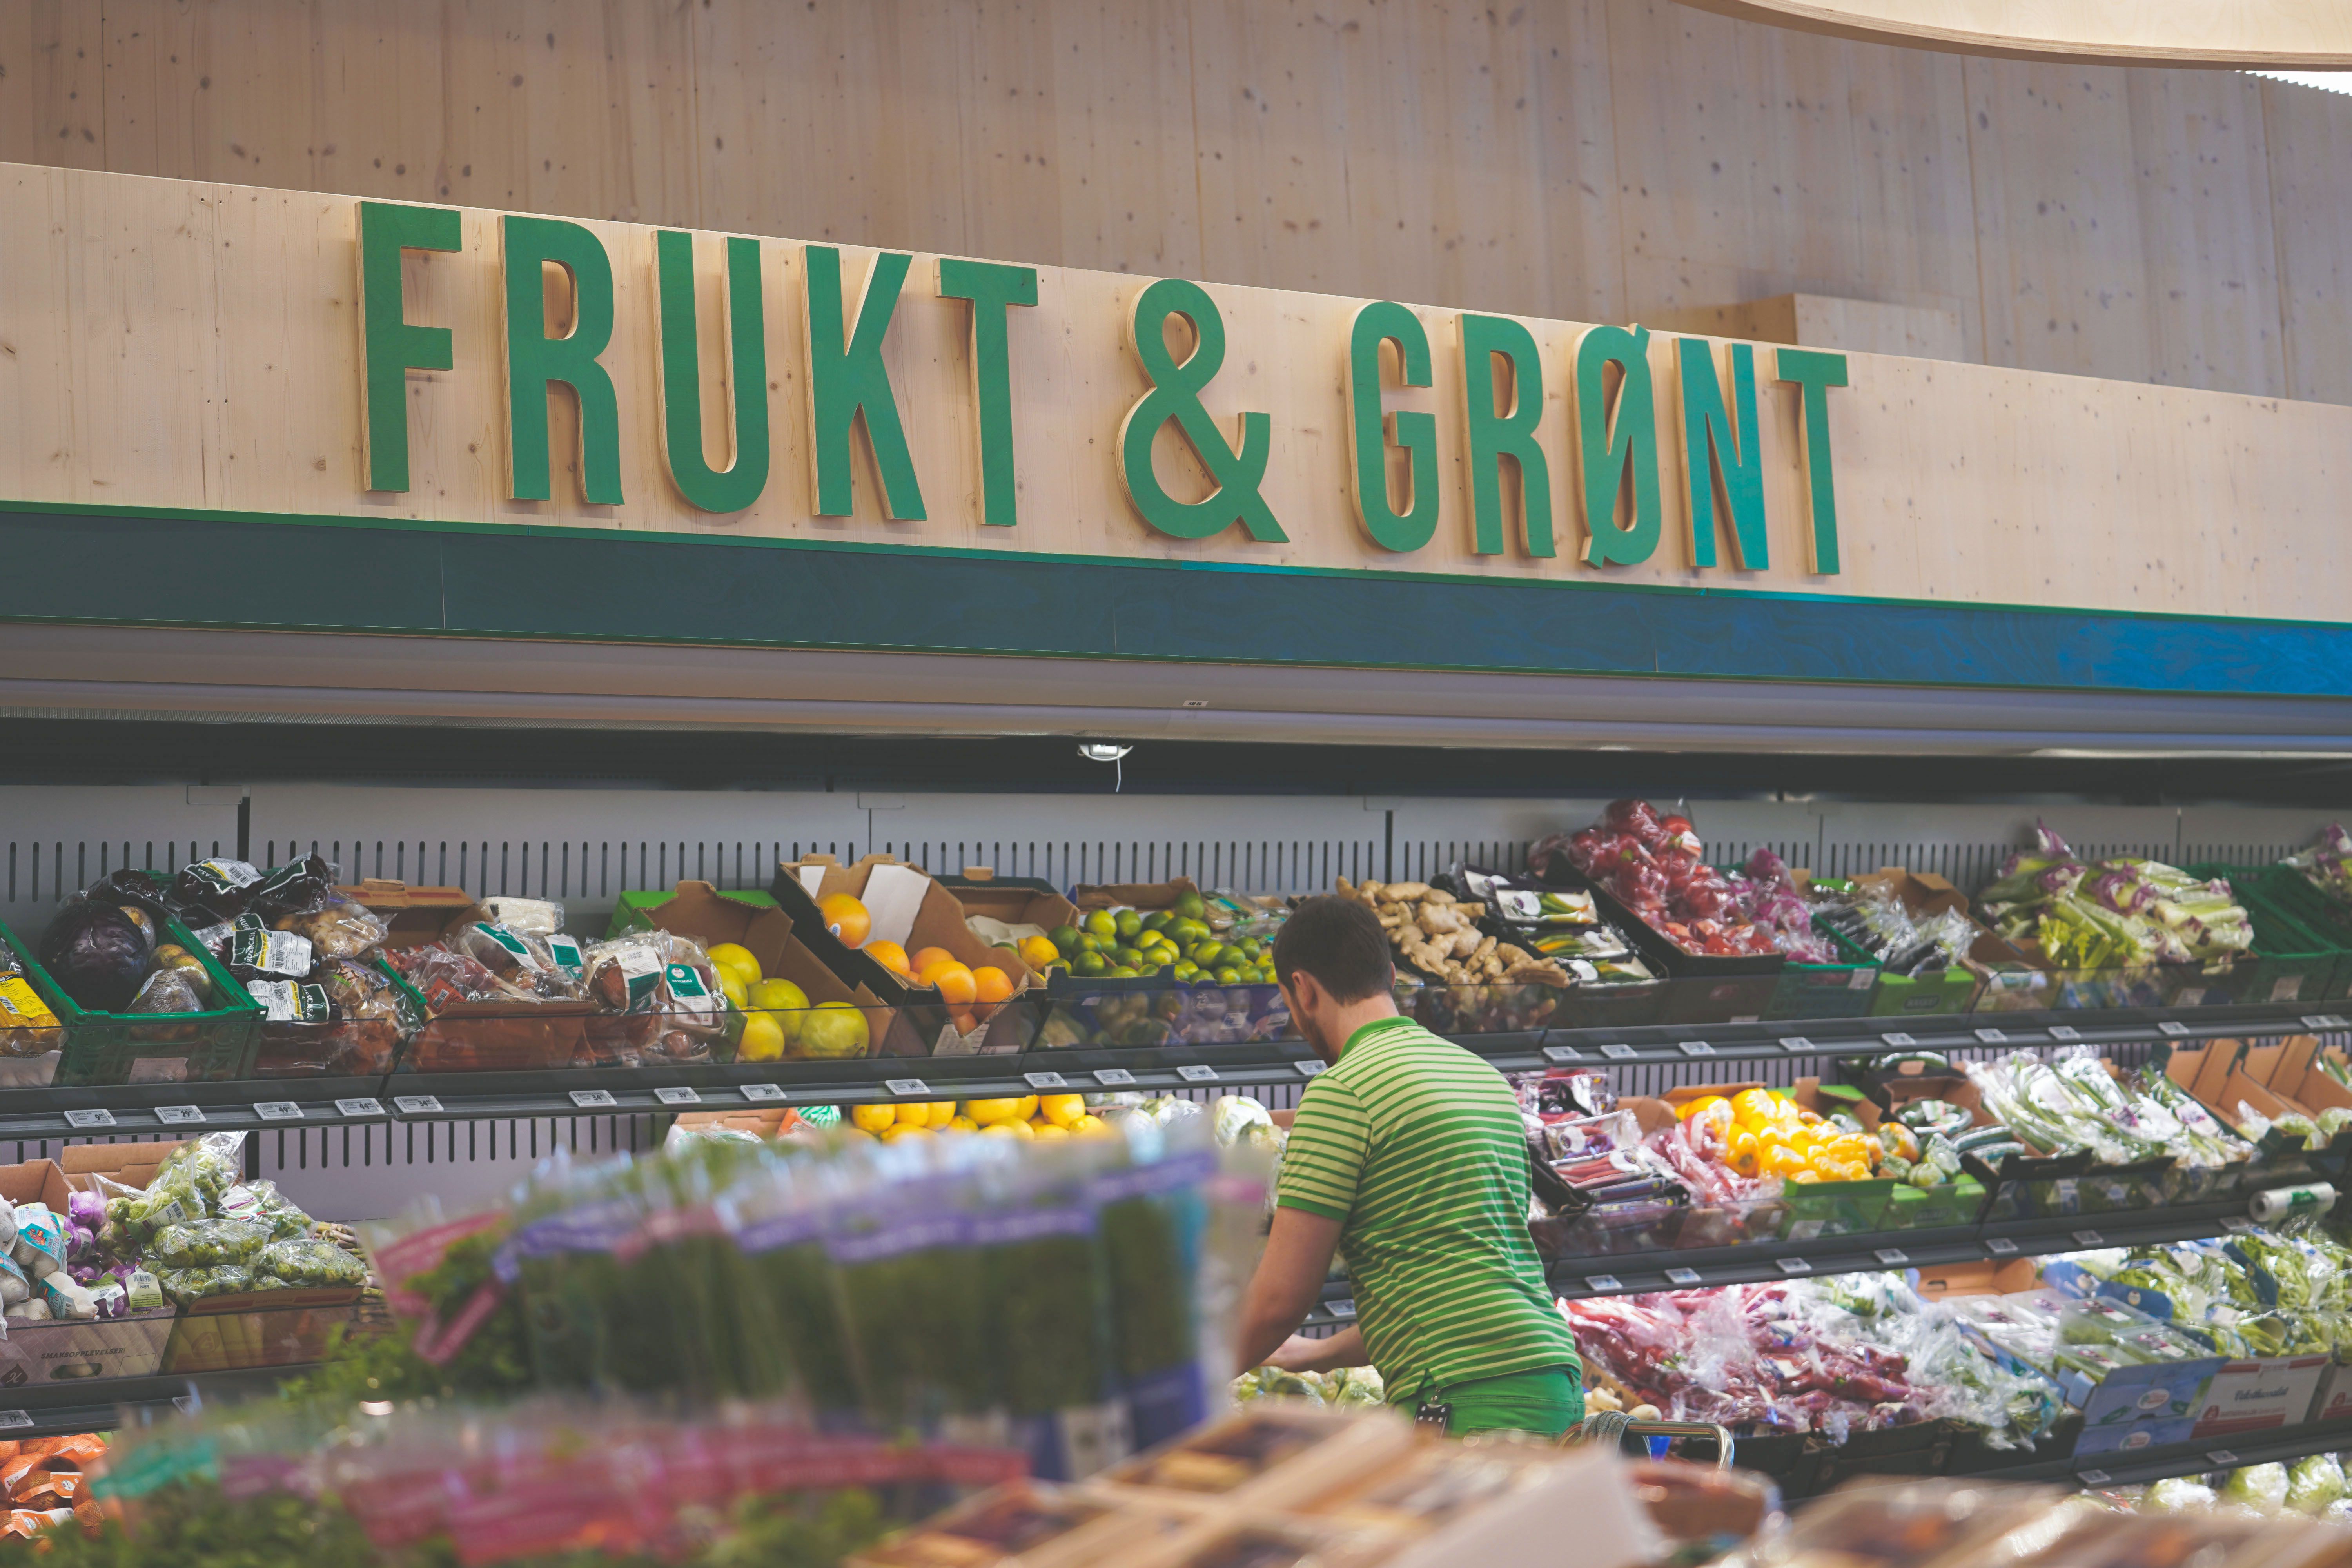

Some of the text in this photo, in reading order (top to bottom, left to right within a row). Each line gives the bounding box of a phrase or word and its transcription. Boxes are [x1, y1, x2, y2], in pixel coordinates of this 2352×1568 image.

[359, 202, 1847, 574] FRUKT & GRØNT
[40, 1347, 126, 1359] SMAKSOPPLEVELSER!
